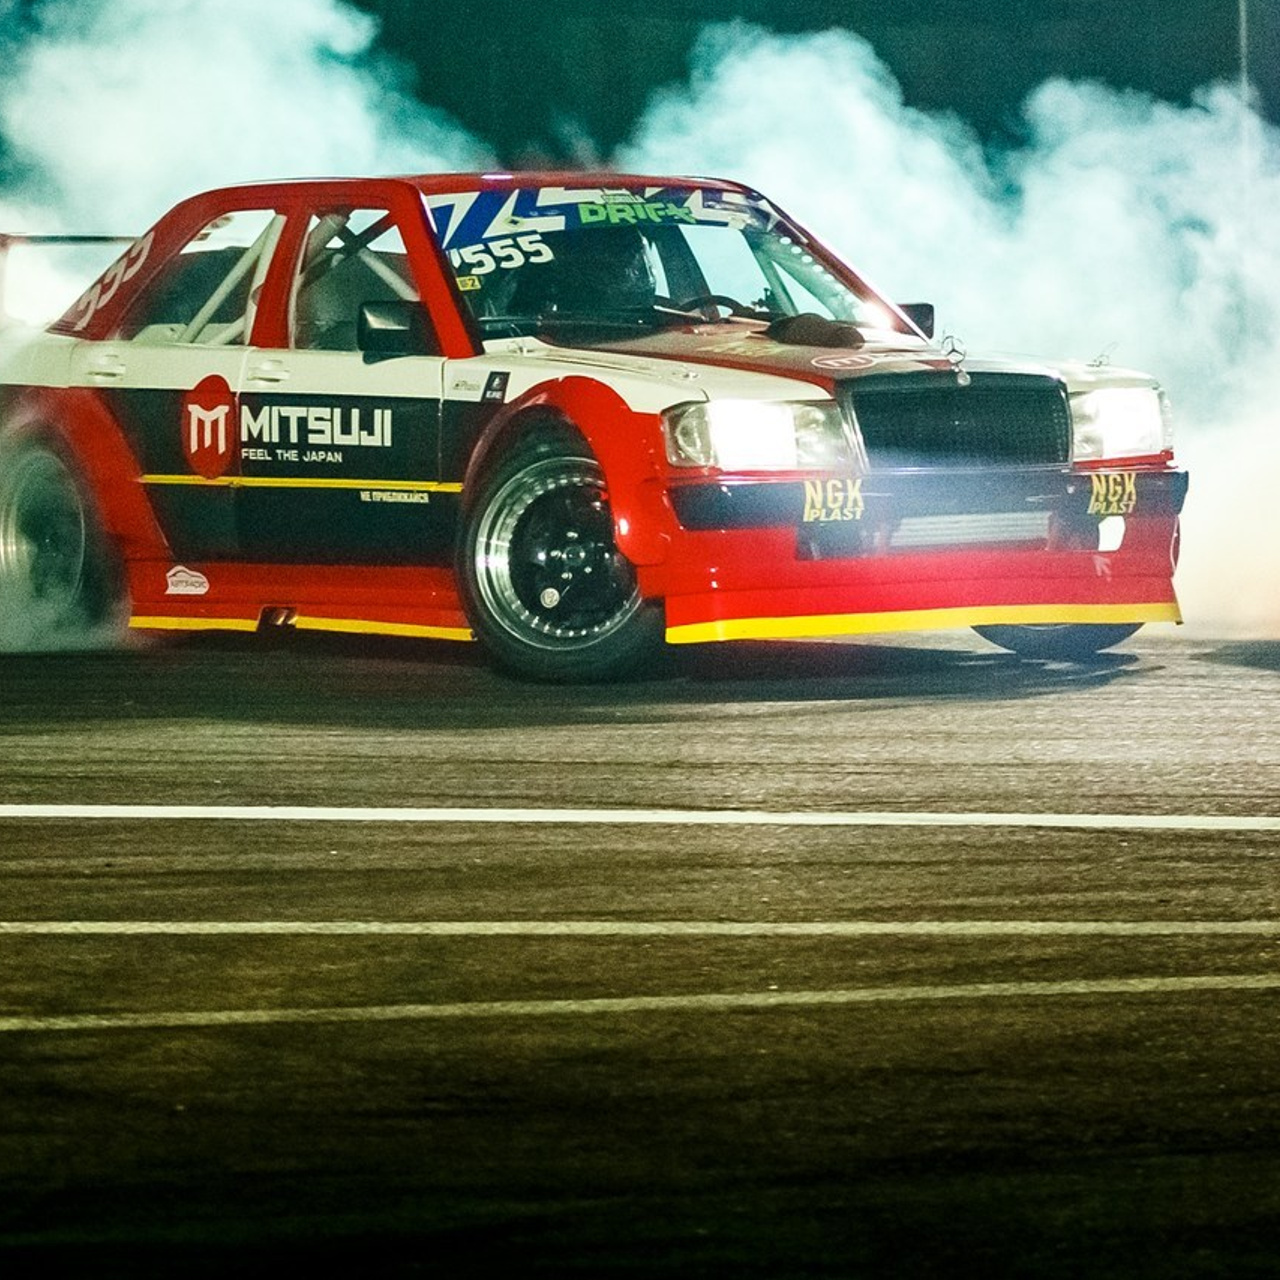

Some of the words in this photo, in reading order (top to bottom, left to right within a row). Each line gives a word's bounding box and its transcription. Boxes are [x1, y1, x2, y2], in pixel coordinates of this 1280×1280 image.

[577, 201, 696, 224] DRIFT
[240, 405, 392, 447] MITSUJI
[241, 448, 272, 460] FEEL
[276, 450, 299, 461] THE
[302, 451, 343, 463] JAPAN
[803, 479, 864, 521] NGK
[1087, 472, 1137, 514] NGK
[808, 508, 865, 522] PLAST
[1092, 501, 1136, 514] PLAST
